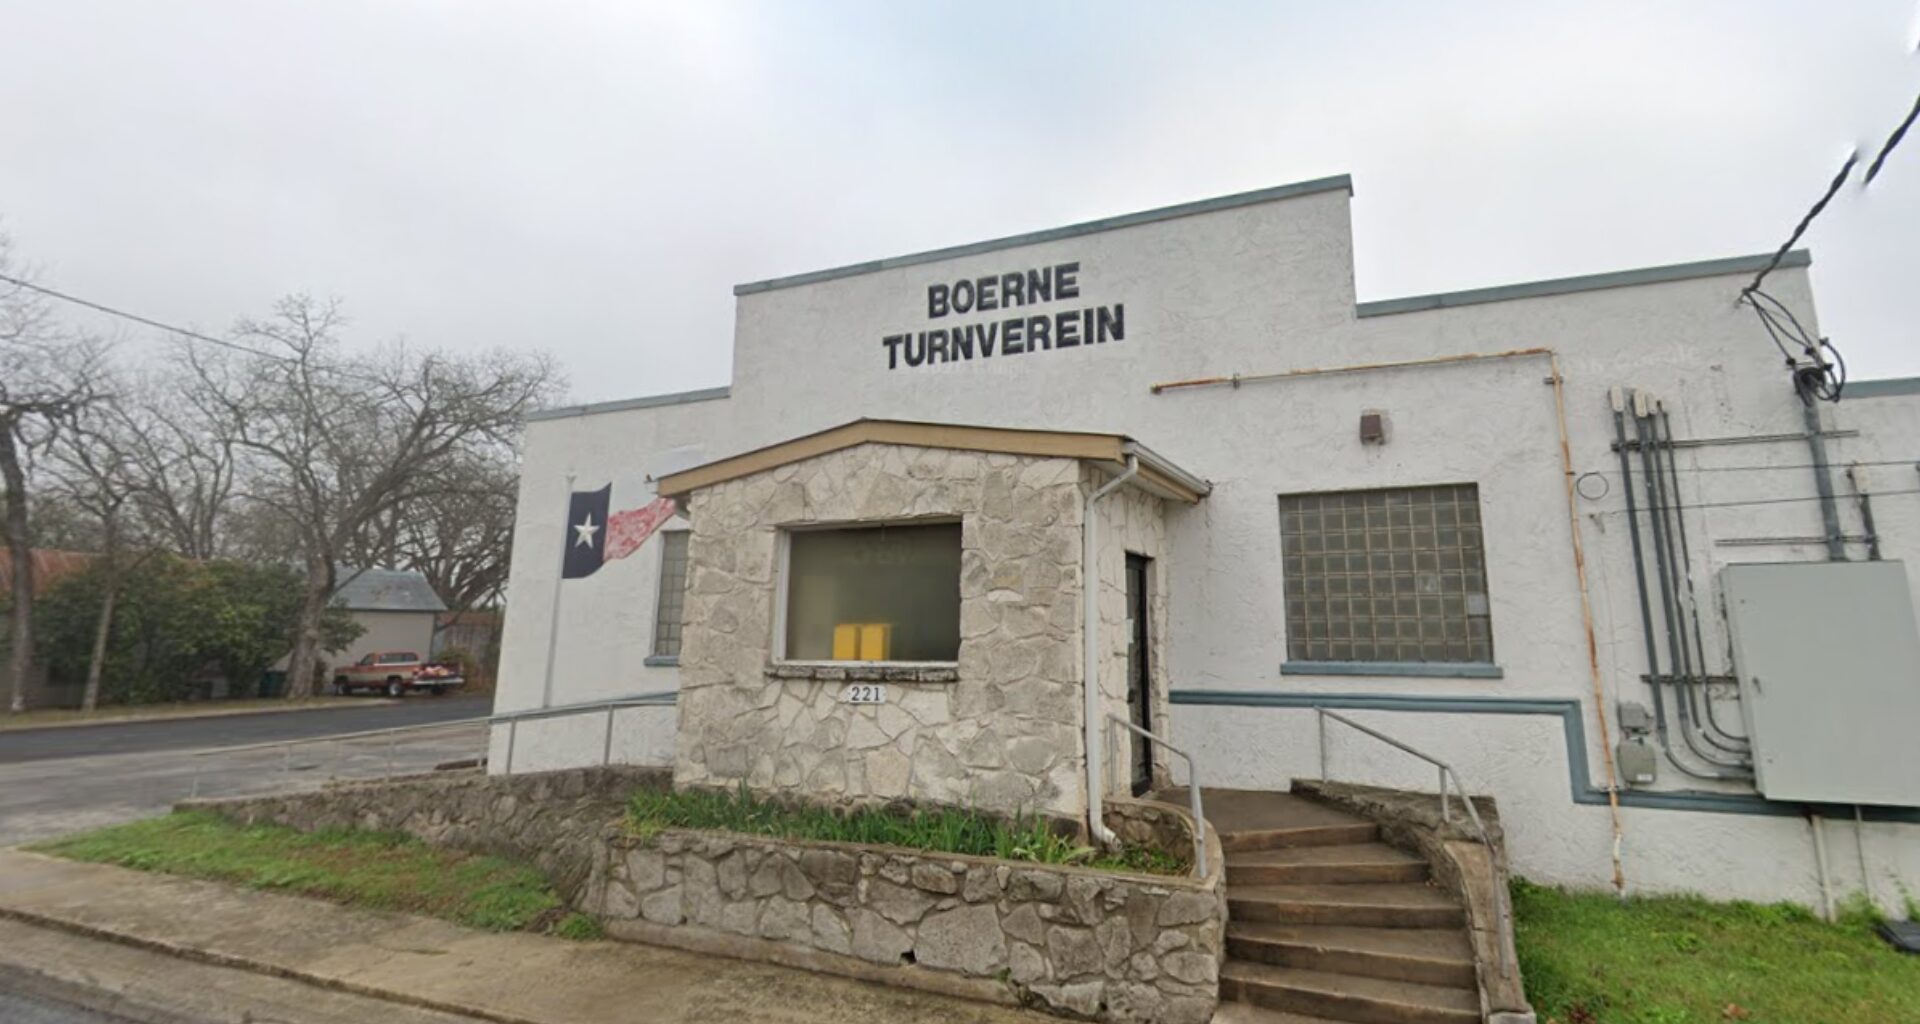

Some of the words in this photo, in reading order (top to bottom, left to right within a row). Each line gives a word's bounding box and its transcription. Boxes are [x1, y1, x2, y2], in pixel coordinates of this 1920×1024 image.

[928, 262, 1080, 319] BOERNE
[883, 303, 1125, 370] TURNVEREIN
[851, 686, 880, 702] 221
